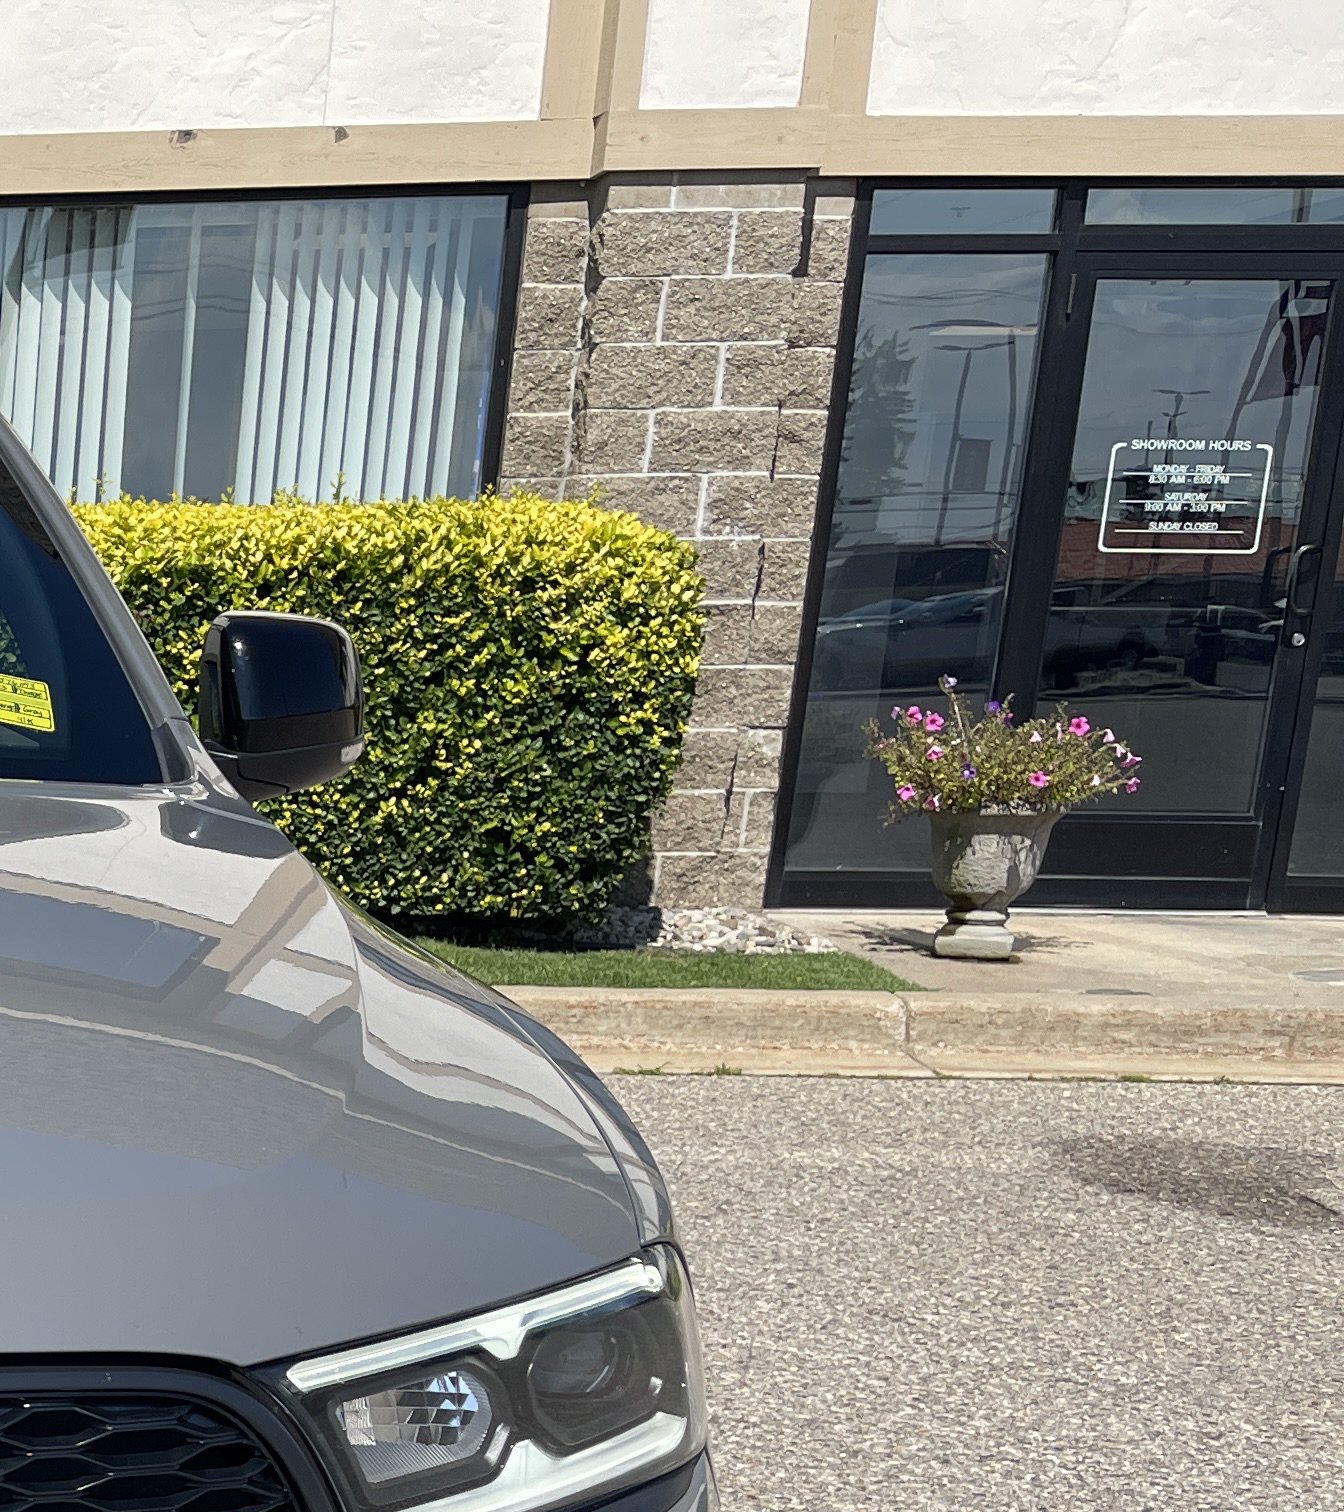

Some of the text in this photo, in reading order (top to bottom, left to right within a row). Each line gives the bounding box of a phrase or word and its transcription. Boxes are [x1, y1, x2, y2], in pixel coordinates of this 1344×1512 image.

[1131, 439, 1252, 451] SHOWROOM HOURS
[1153, 464, 1189, 473] MONDAY
[1195, 465, 1225, 473] FRIDAY
[1169, 475, 1186, 484] AM
[1214, 475, 1230, 484] PM
[1164, 492, 1209, 501] SATURDAY
[1165, 503, 1182, 512] AM
[1210, 504, 1226, 513] PM
[1148, 521, 1219, 531] SUNDAY CLOSED
